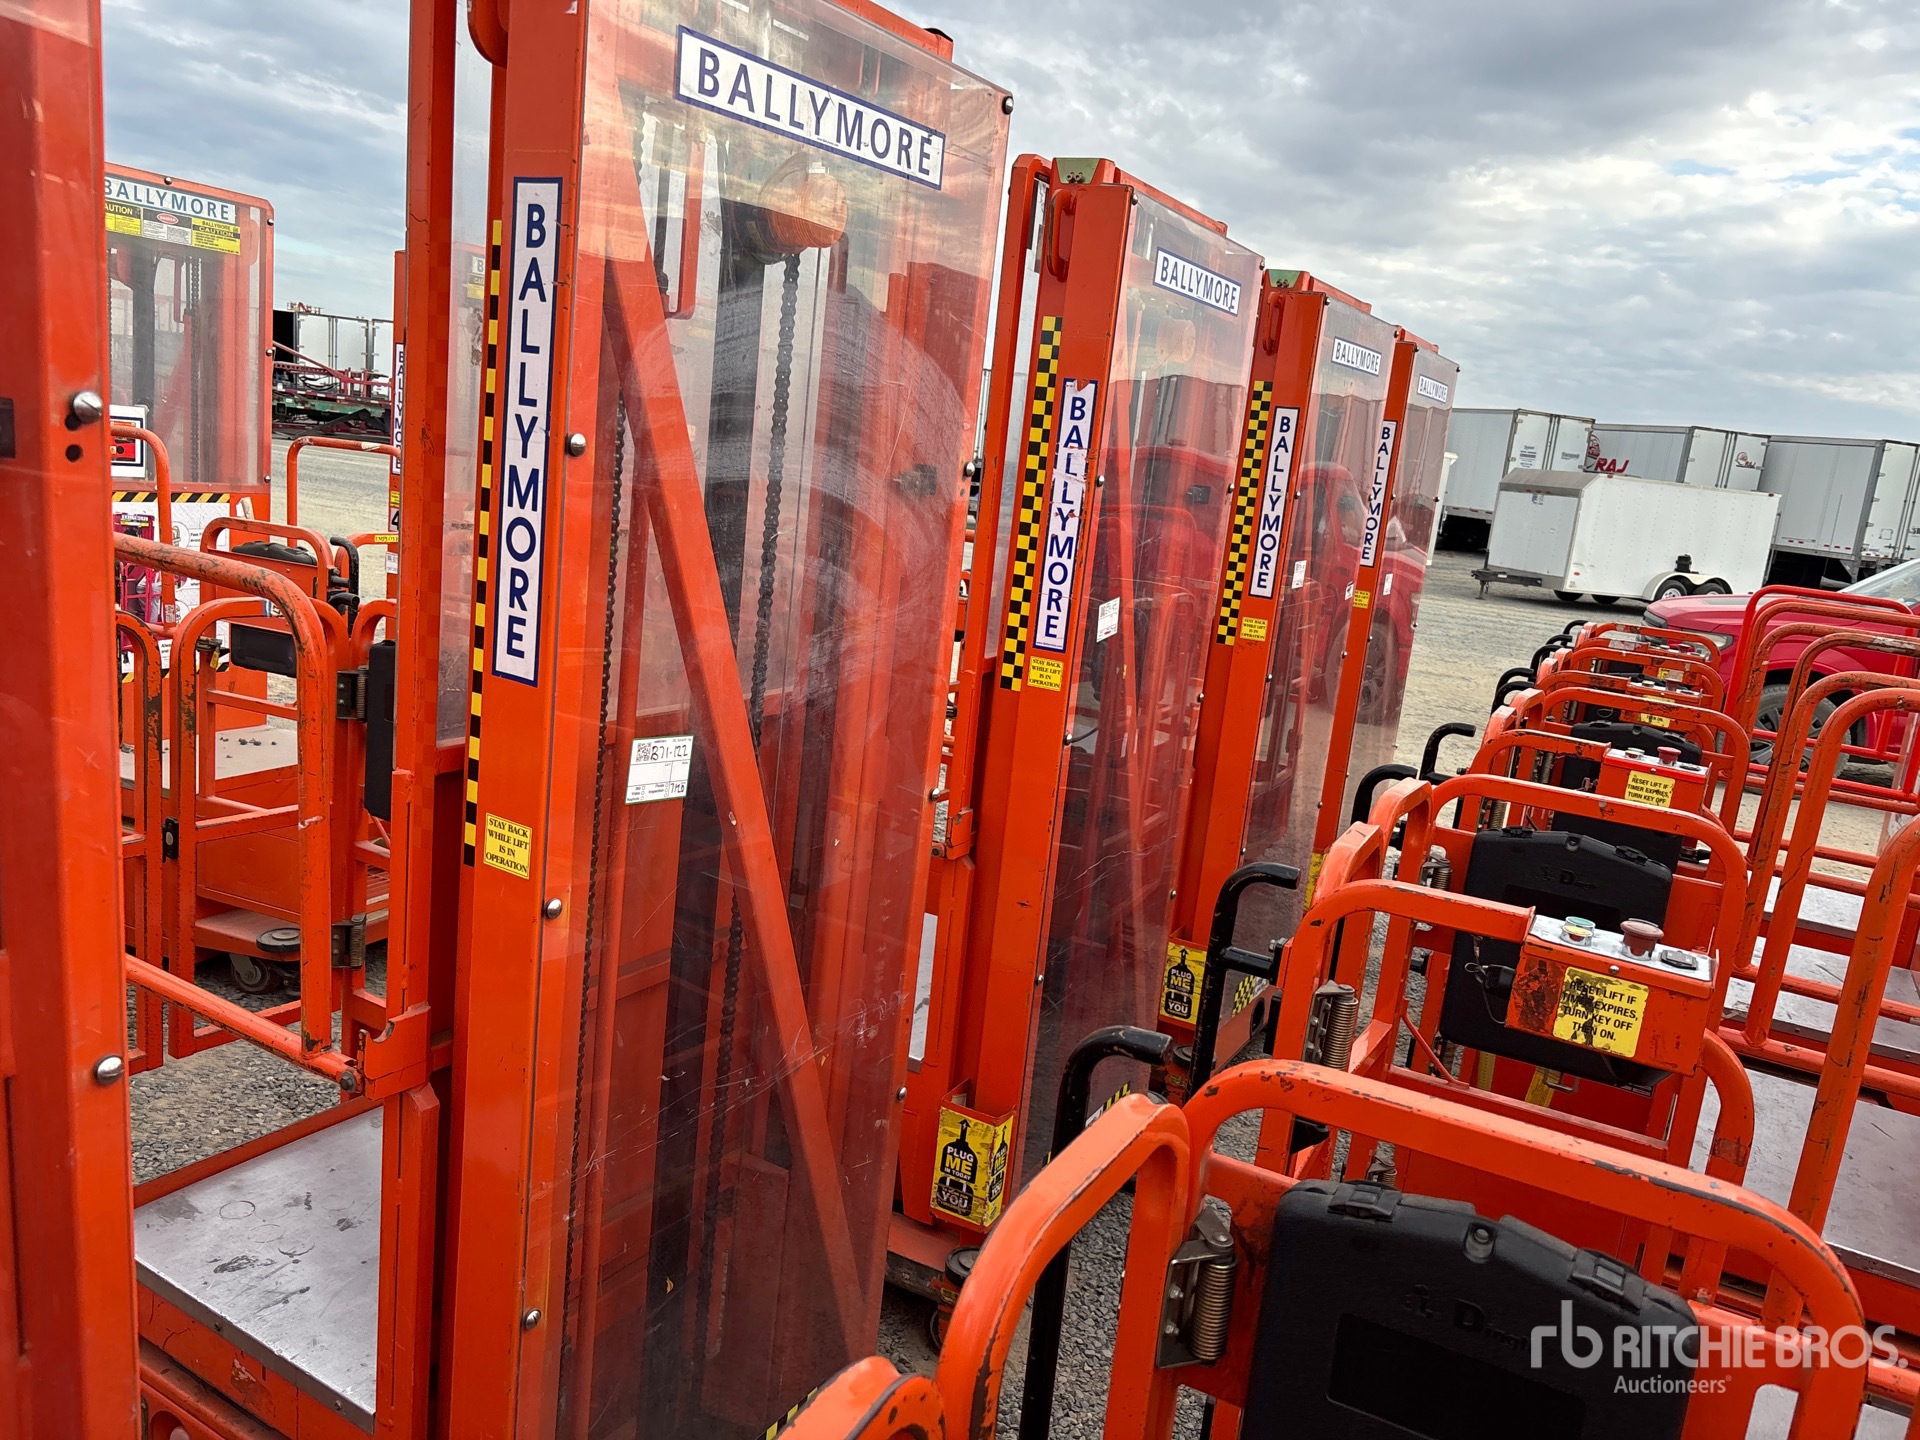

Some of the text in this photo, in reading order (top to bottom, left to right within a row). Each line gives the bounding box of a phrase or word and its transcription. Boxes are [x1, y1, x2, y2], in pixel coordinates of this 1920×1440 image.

[698, 47, 932, 176] BALLYMORE
[105, 204, 133, 215] AUTION
[199, 226, 234, 237] CAUTION
[1161, 256, 1236, 310] BALLYMORE
[1336, 342, 1379, 372] BALLYMORE
[1420, 378, 1447, 400] BALLYMORE
[505, 203, 547, 659] BALLYMORE
[1594, 458, 1629, 473] RAJ
[1362, 427, 1391, 560] BALLYMORE
[1257, 416, 1291, 589] BALLYMORE
[1044, 397, 1086, 639] BALLYMORE
[1029, 679, 1060, 688] OPERATION
[1628, 784, 1644, 792] TIMER
[1632, 778, 1649, 786] RESET
[1644, 794, 1654, 802] KEY
[489, 818, 528, 838] STAY BACK
[488, 829, 529, 850] WHILE LIFT
[499, 845, 515, 857] IS IN
[486, 852, 527, 873] OPERATION
[1171, 969, 1191, 979] PLUG
[1170, 975, 1191, 990] ME
[1603, 990, 1625, 1002] LIFT
[1627, 996, 1637, 1004] IF
[1169, 1002, 1188, 1013] YOU
[1595, 1000, 1638, 1021] EXPIRES,
[1563, 1006, 1633, 1031] TURN KEY OFF
[1600, 1029, 1616, 1041] ON.
[947, 1146, 974, 1162] PLUG
[945, 1155, 972, 1176] ME
[952, 1170, 971, 1180] TODAY
[942, 1191, 968, 1208] YOU
